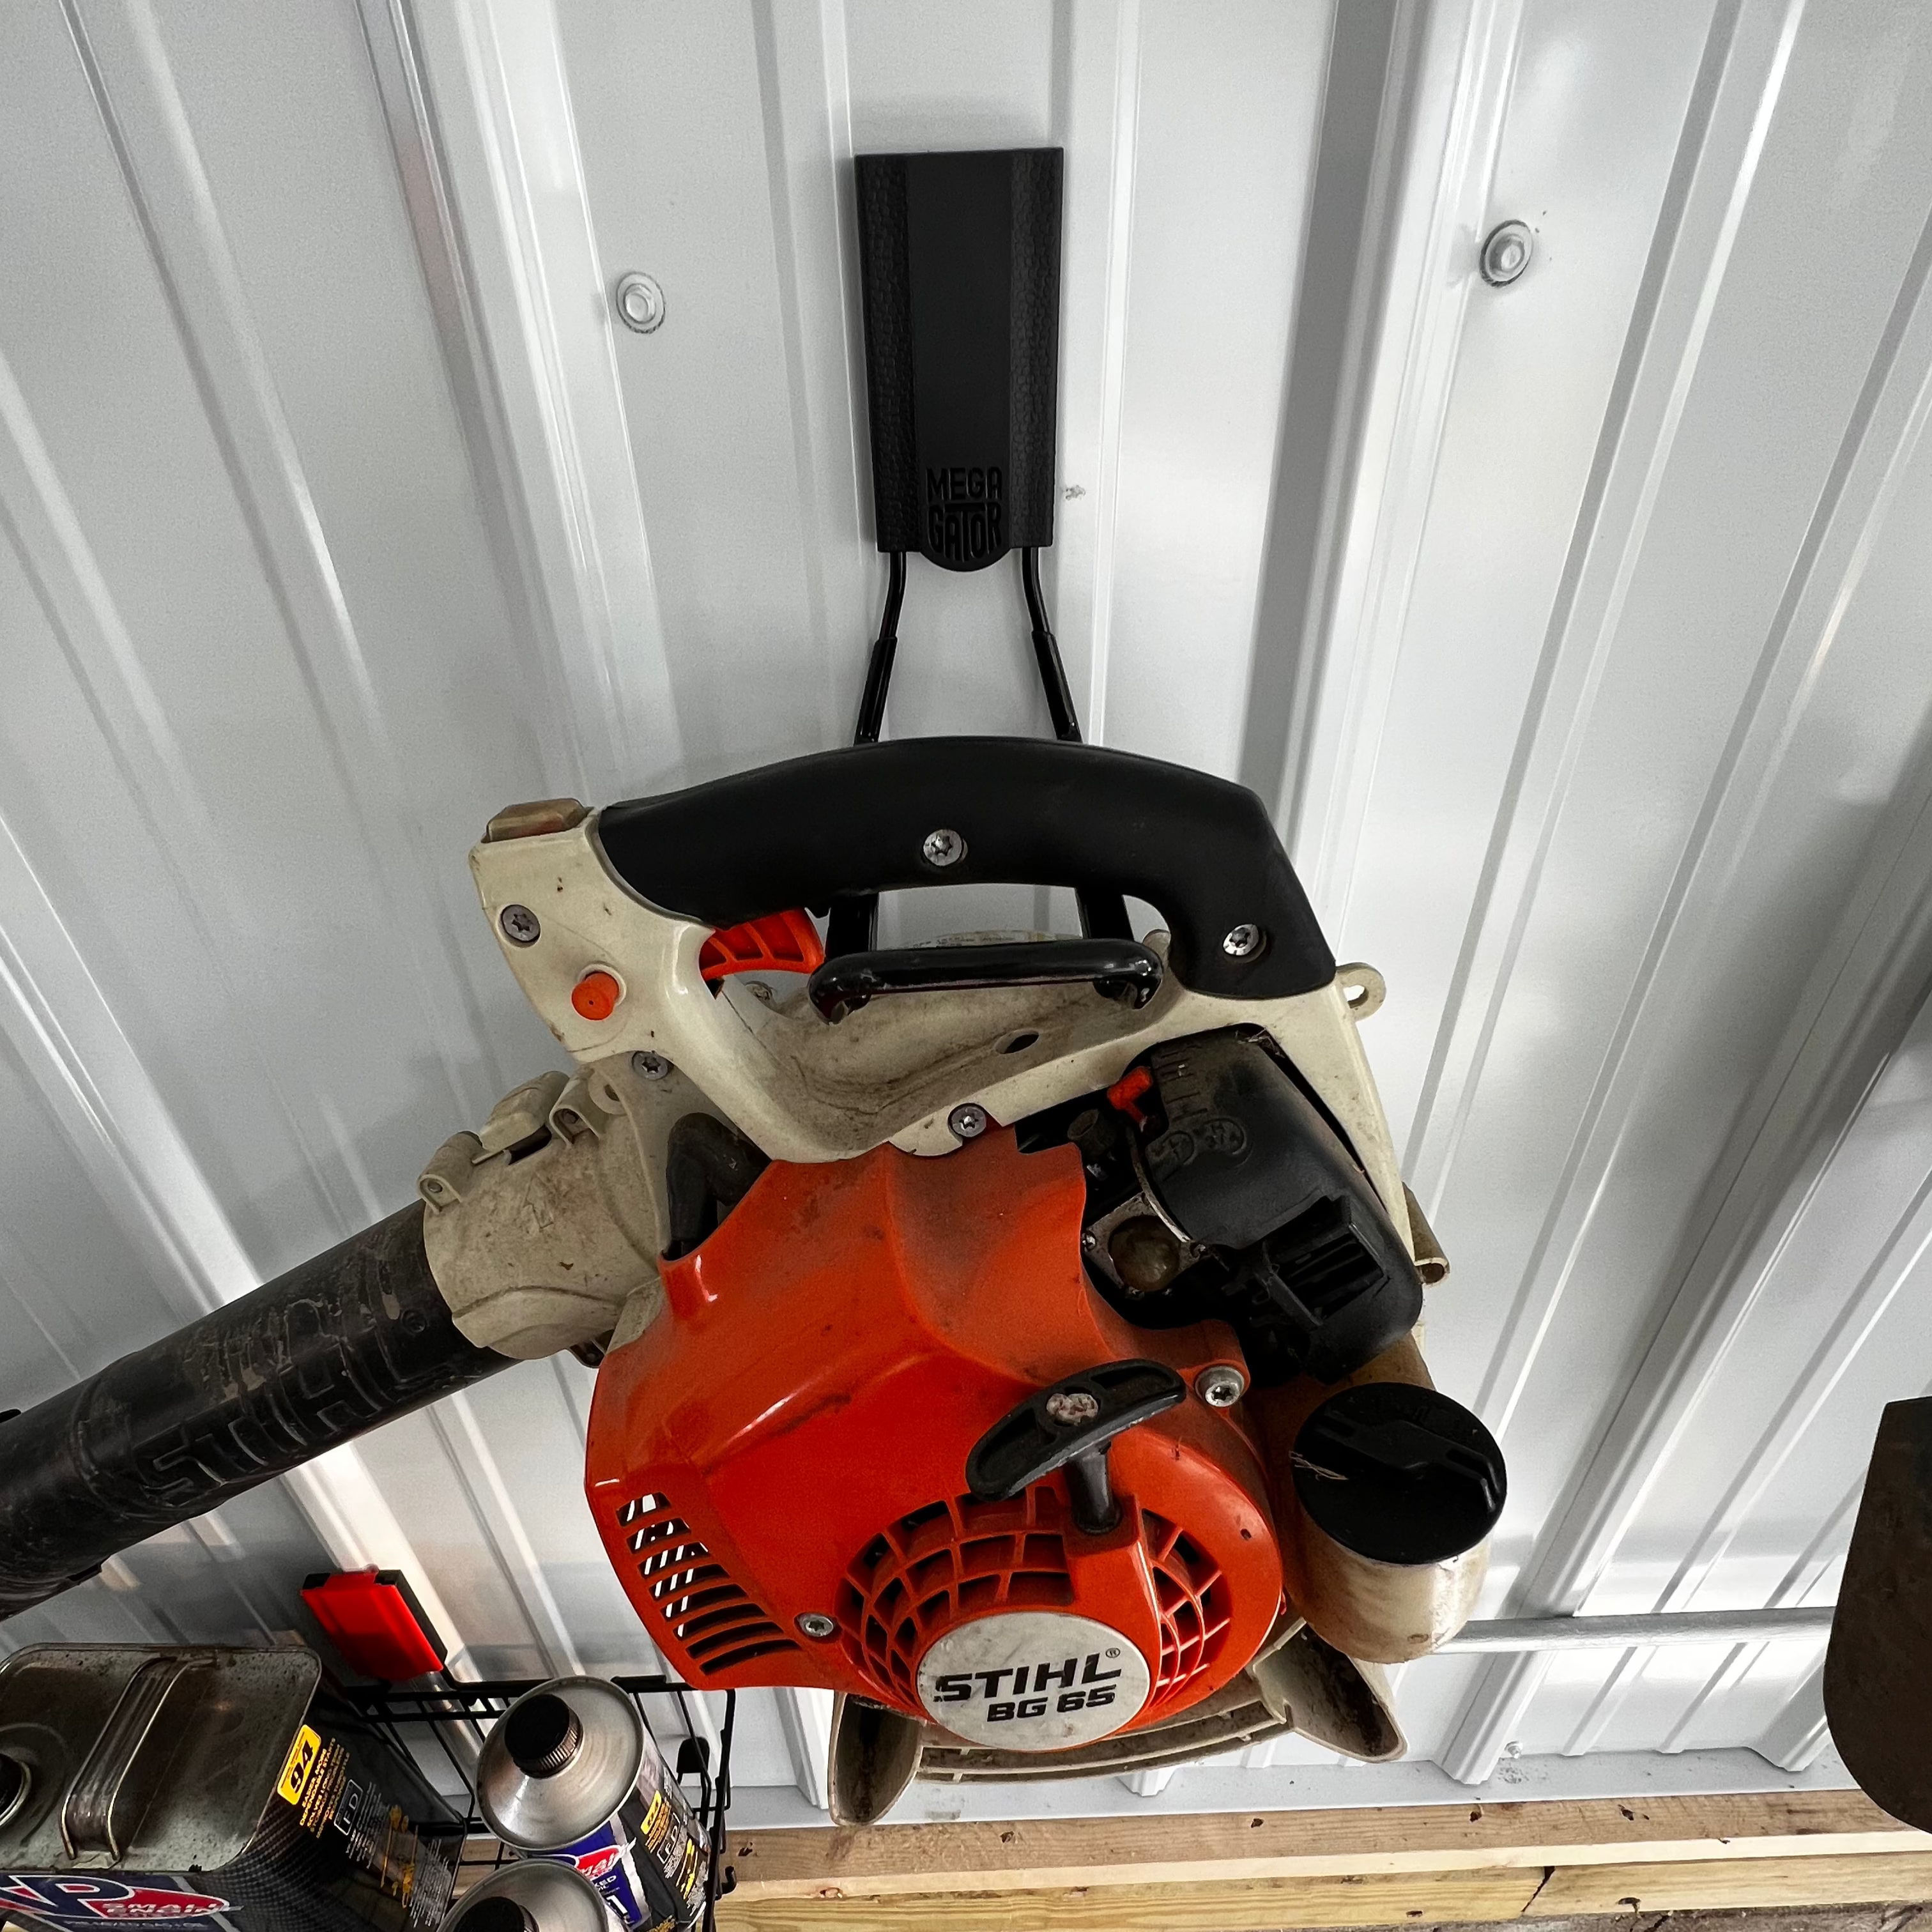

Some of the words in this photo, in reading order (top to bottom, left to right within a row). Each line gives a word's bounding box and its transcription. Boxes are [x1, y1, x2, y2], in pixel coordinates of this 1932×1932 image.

[926, 466, 1002, 502] MEGA
[928, 502, 1002, 562] GATOR
[987, 1697, 1048, 1722] BG
[1056, 1684, 1117, 1713] 65
[290, 1739, 314, 1794] 94
